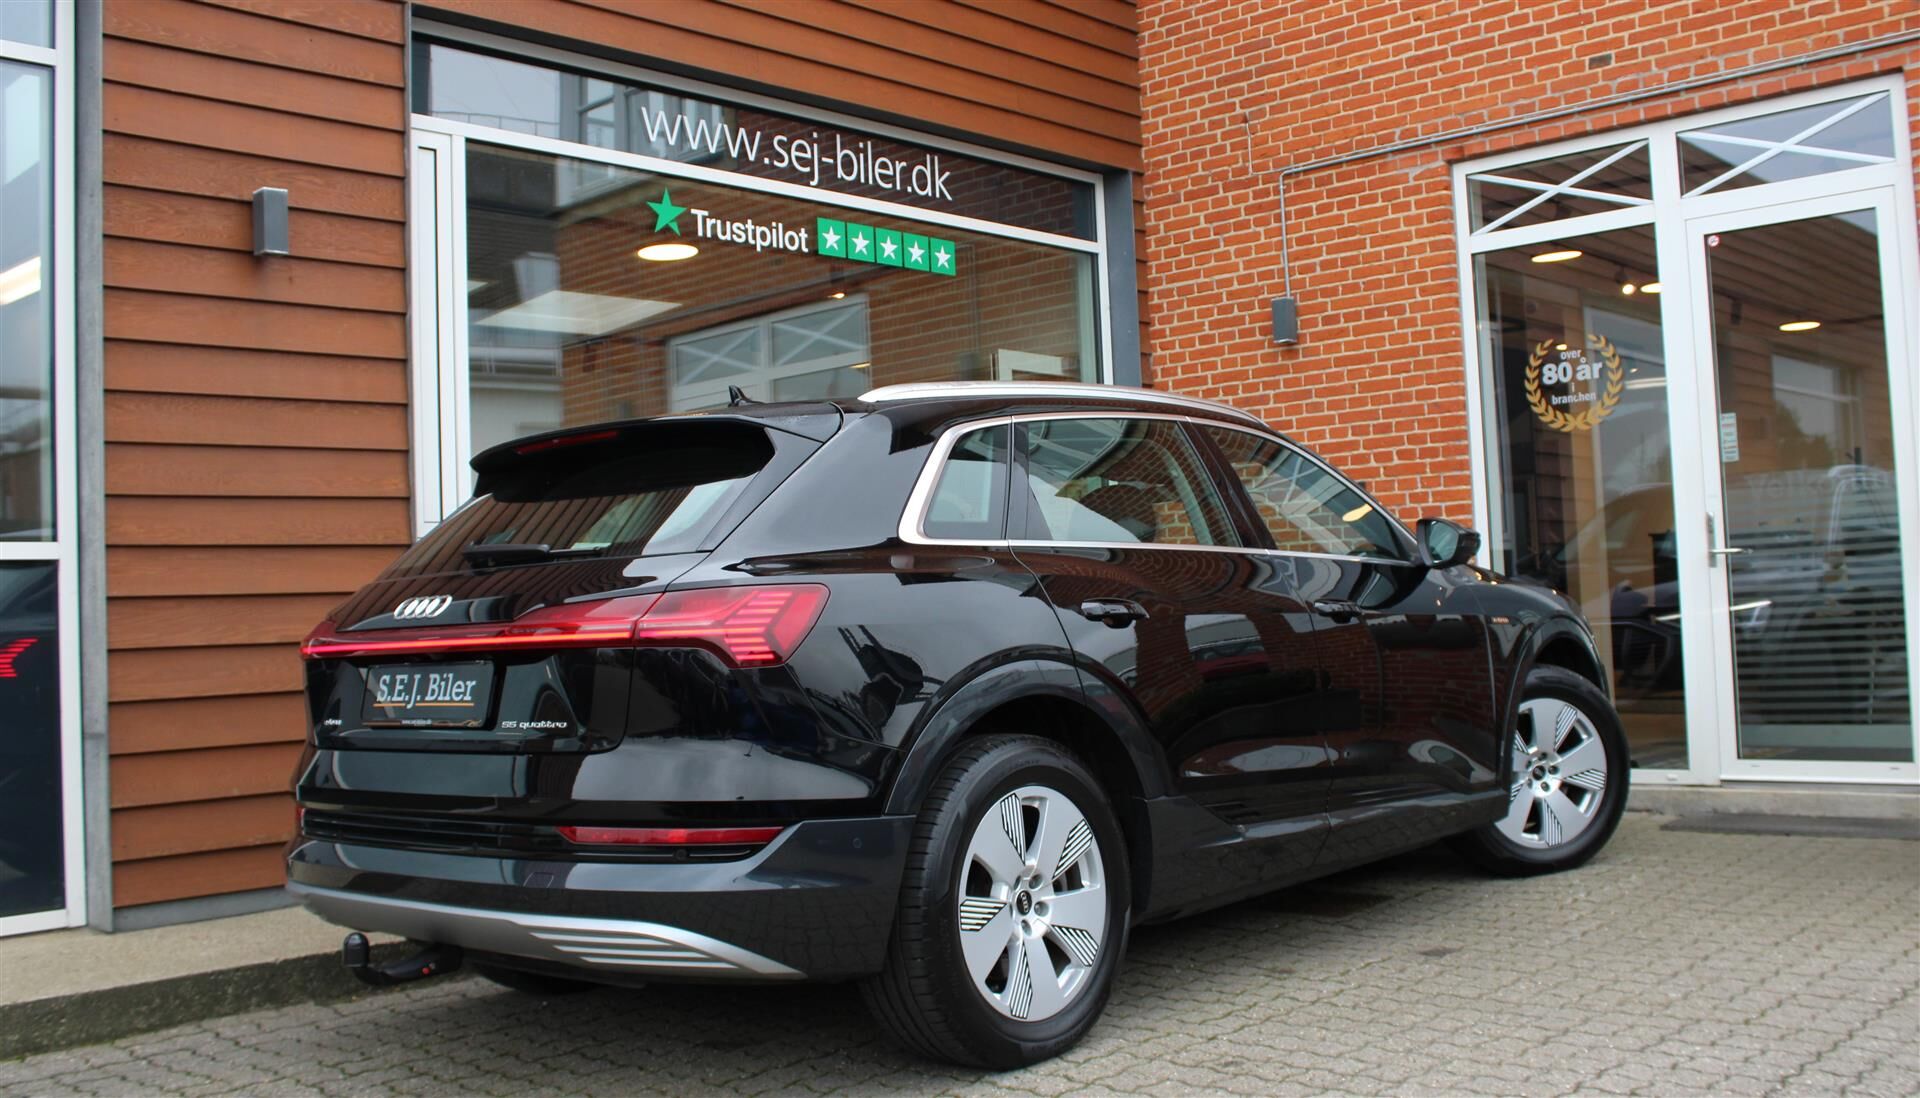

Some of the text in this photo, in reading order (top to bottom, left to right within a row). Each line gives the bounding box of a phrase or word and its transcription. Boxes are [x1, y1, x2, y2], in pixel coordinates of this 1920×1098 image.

[641, 106, 952, 201] www.sej-biler.dk
[690, 208, 809, 253] Trustpilot
[1560, 350, 1582, 360] over
[1542, 357, 1603, 385] 80 år
[1551, 392, 1597, 405] branchen
[376, 672, 476, 709] S.E.J. Biler
[501, 720, 568, 730] 55 quattro
